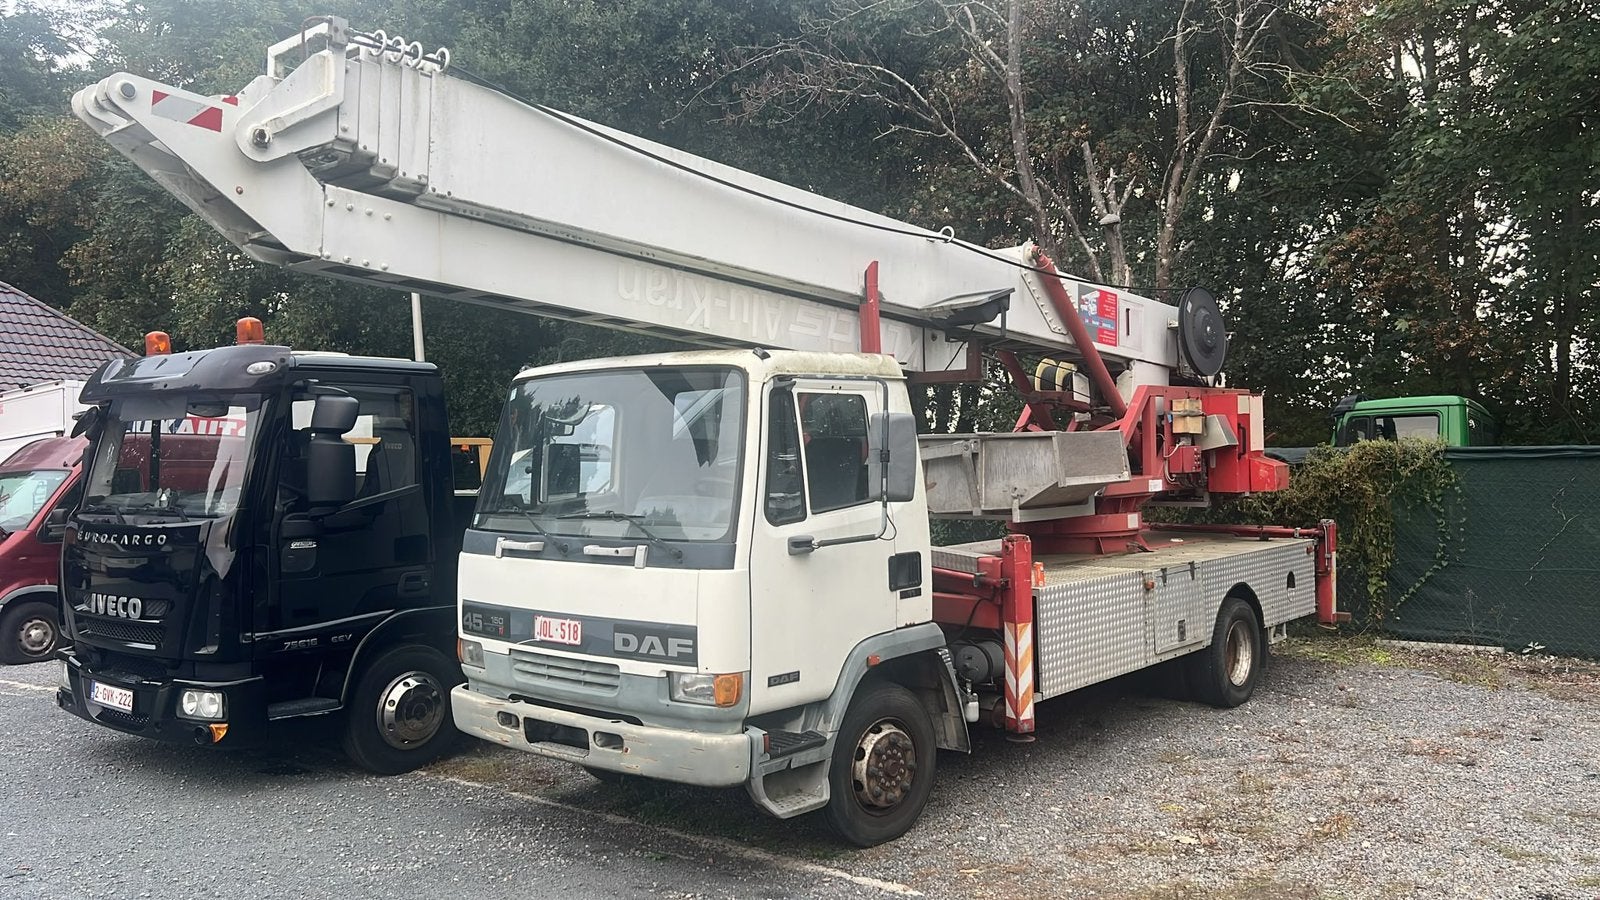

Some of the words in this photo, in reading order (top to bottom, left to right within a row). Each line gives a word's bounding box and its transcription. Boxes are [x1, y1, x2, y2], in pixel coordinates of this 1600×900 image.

[617, 265, 785, 341] Alu-Kran
[77, 530, 167, 545] EUROCARGO
[91, 593, 142, 619] IVECO
[464, 612, 483, 632] 45
[490, 616, 504, 625] 150
[614, 632, 693, 657] DAF
[770, 672, 798, 686] DAF
